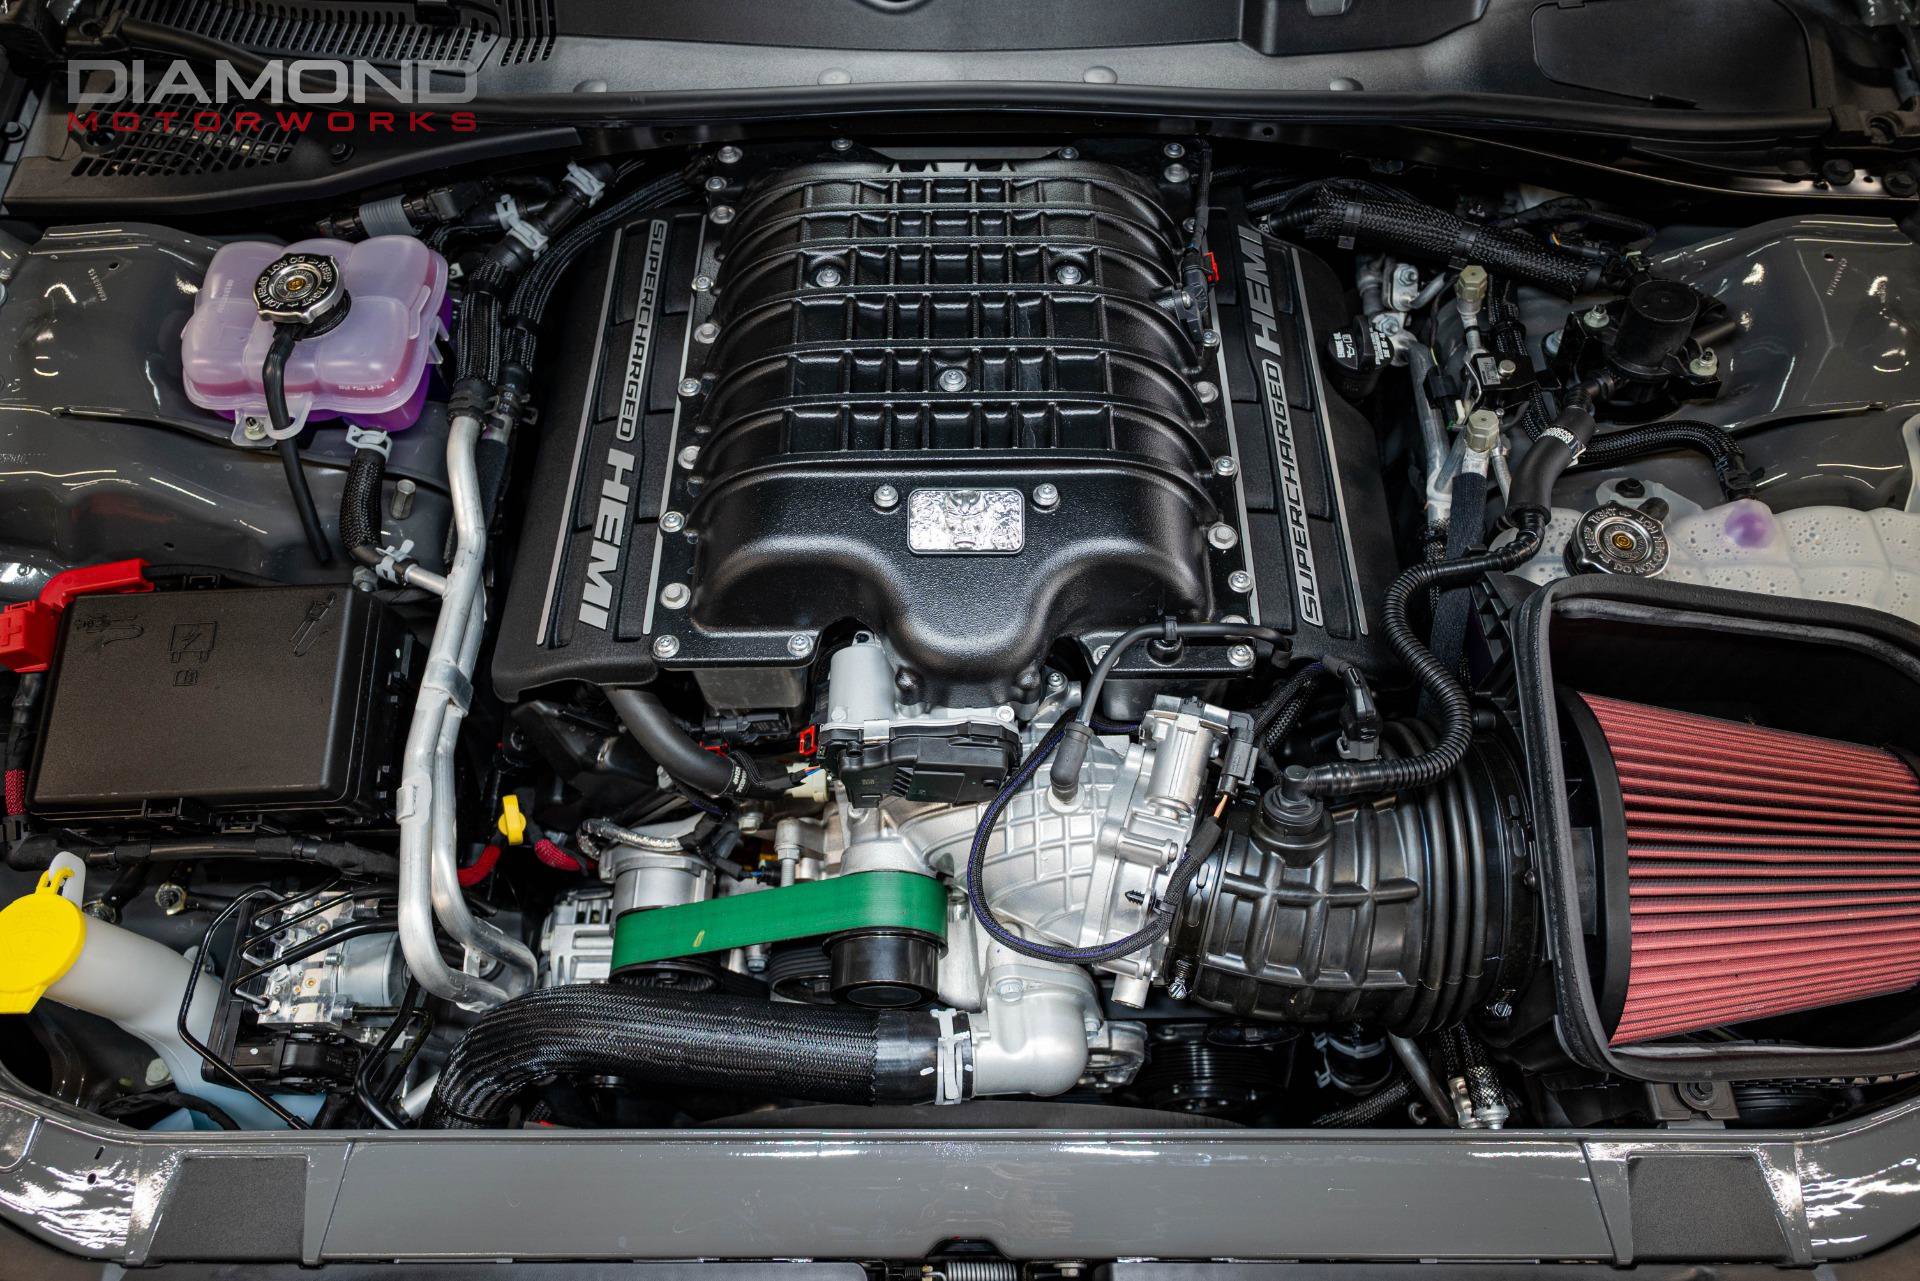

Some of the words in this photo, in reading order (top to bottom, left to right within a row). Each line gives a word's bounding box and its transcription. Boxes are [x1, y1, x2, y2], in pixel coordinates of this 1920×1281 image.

[268, 260, 288, 276] NOT
[289, 255, 305, 264] DO
[262, 296, 284, 309] HOT
[302, 286, 329, 307] TIGHT
[1237, 225, 1281, 357] HEMI
[619, 221, 665, 438] SUPERCHARGED
[1265, 362, 1321, 622] SUPERCHARGED
[579, 448, 635, 630] HEMI
[1614, 562, 1632, 574] DO
[1635, 516, 1659, 534] HOT
